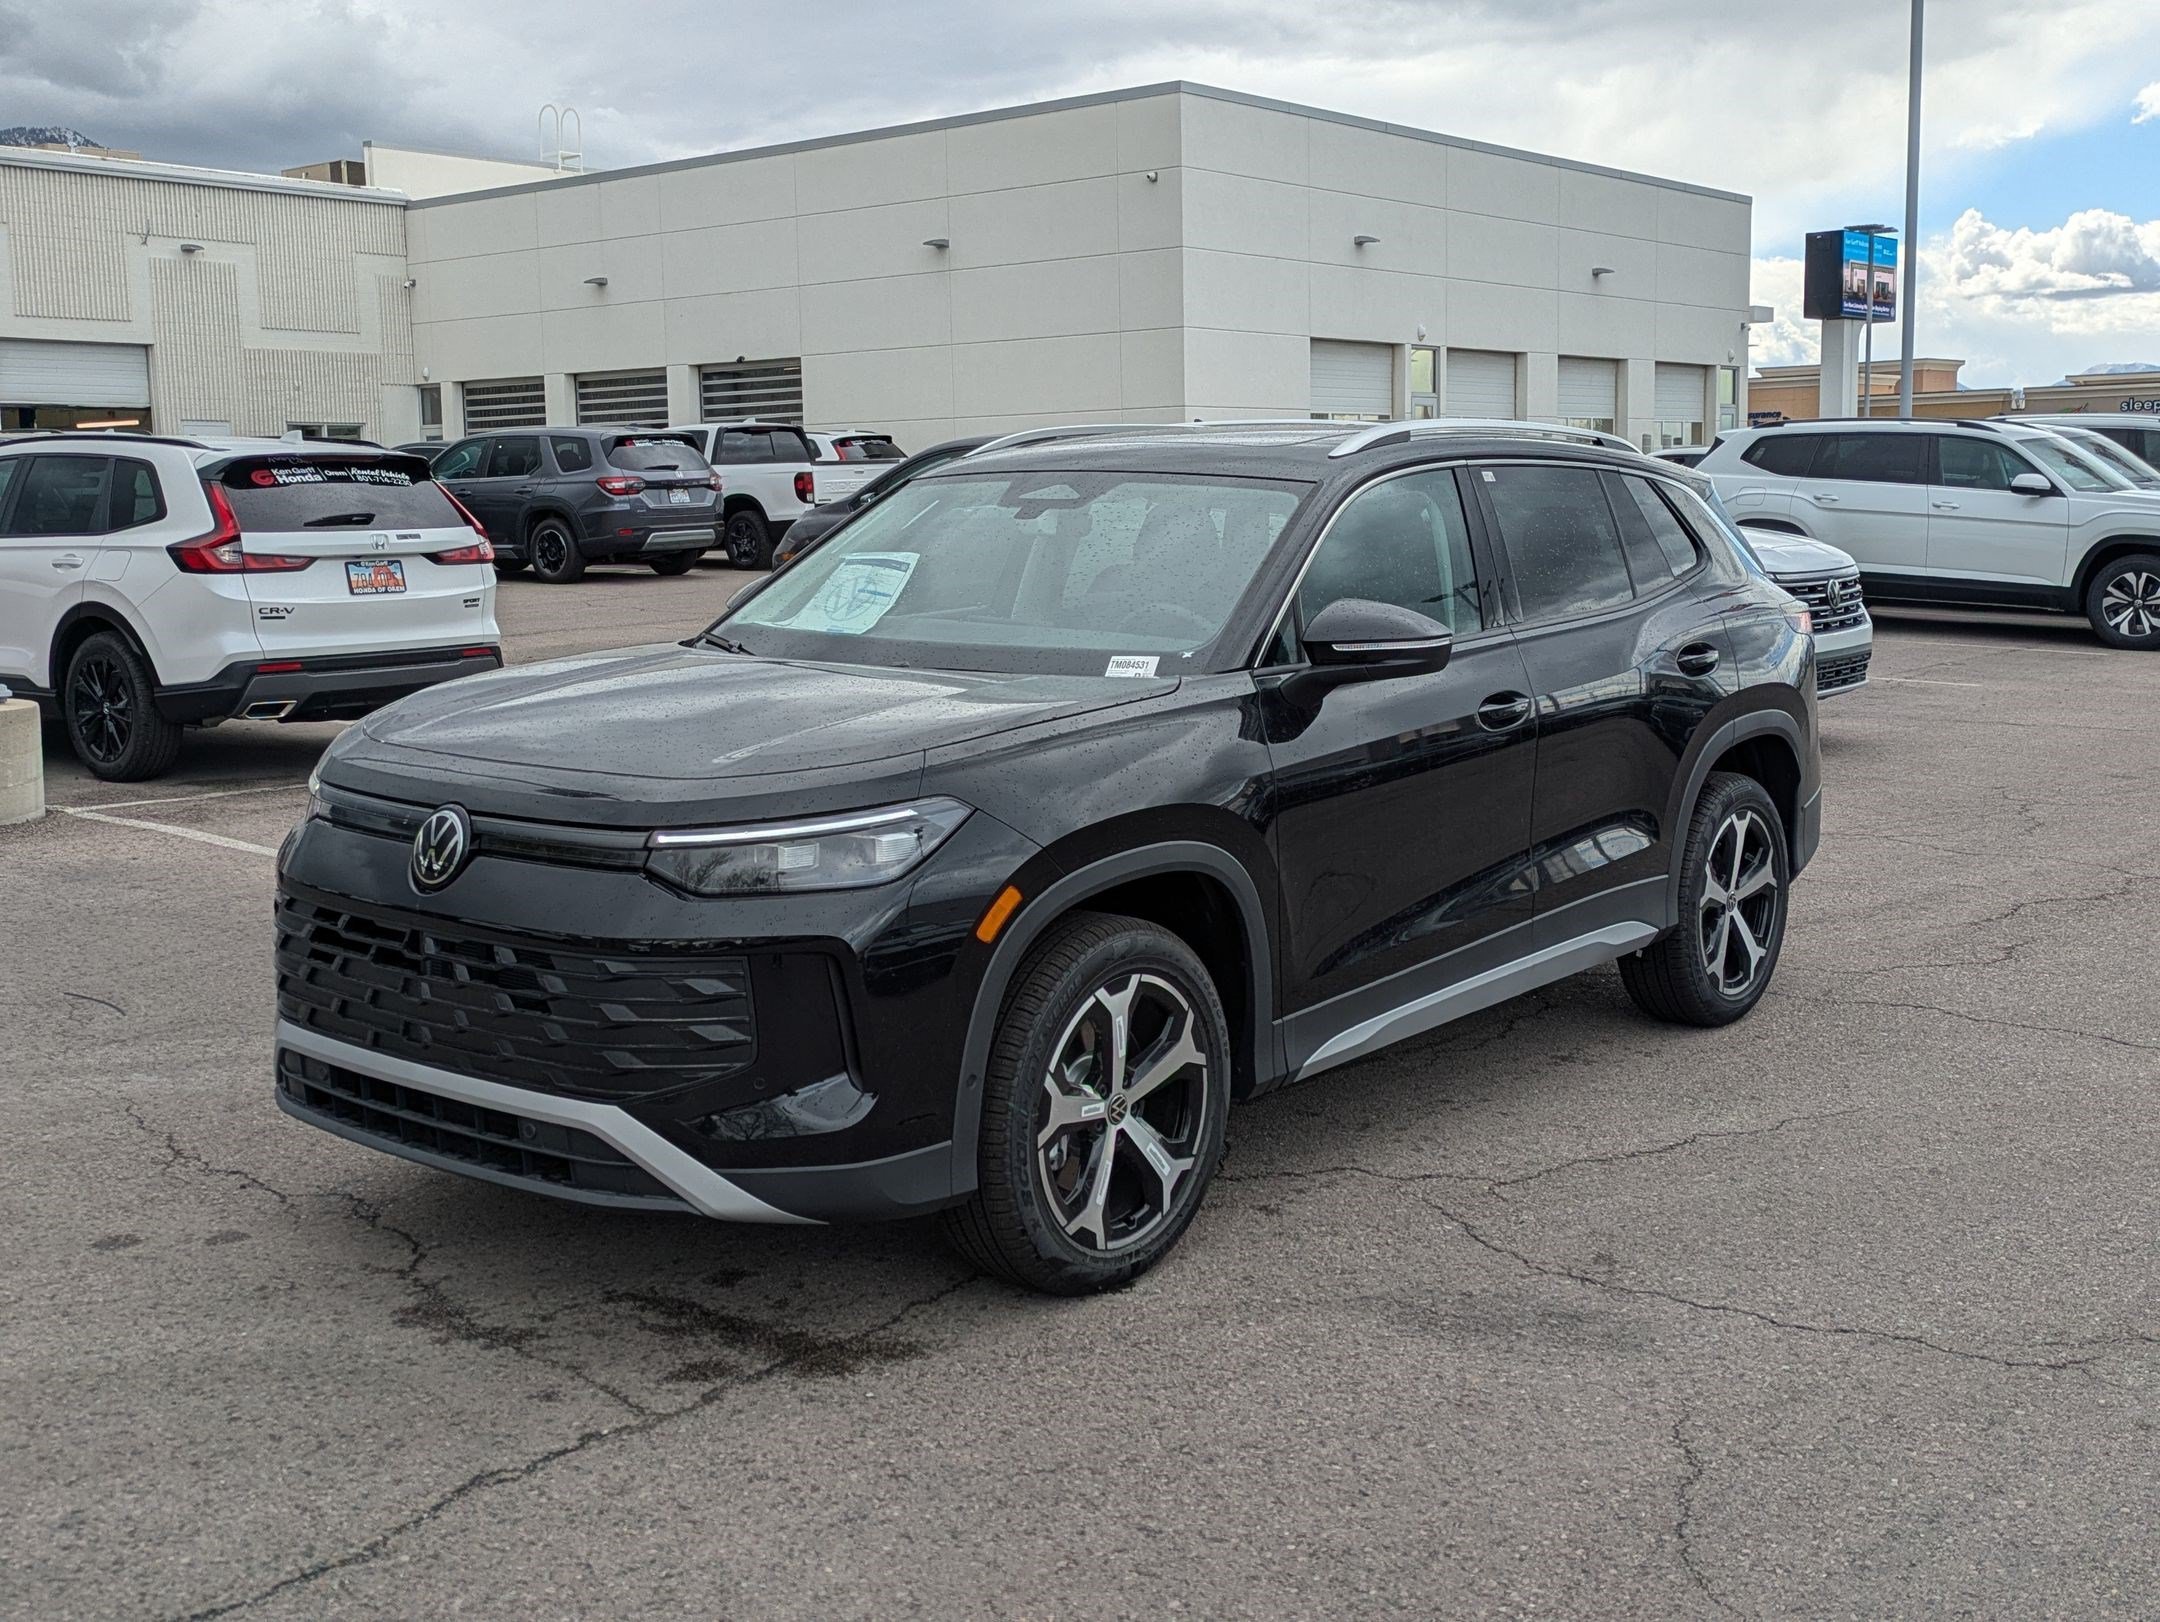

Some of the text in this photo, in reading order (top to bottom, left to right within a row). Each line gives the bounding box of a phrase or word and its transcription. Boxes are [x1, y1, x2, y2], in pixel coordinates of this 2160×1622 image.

[271, 466, 316, 476] Ken Garff
[325, 469, 348, 477] Orem
[351, 467, 410, 480] Rental Vehicle
[276, 473, 323, 484] Honda
[258, 606, 296, 615] CR-V
[1110, 660, 1150, 669] TM084531
